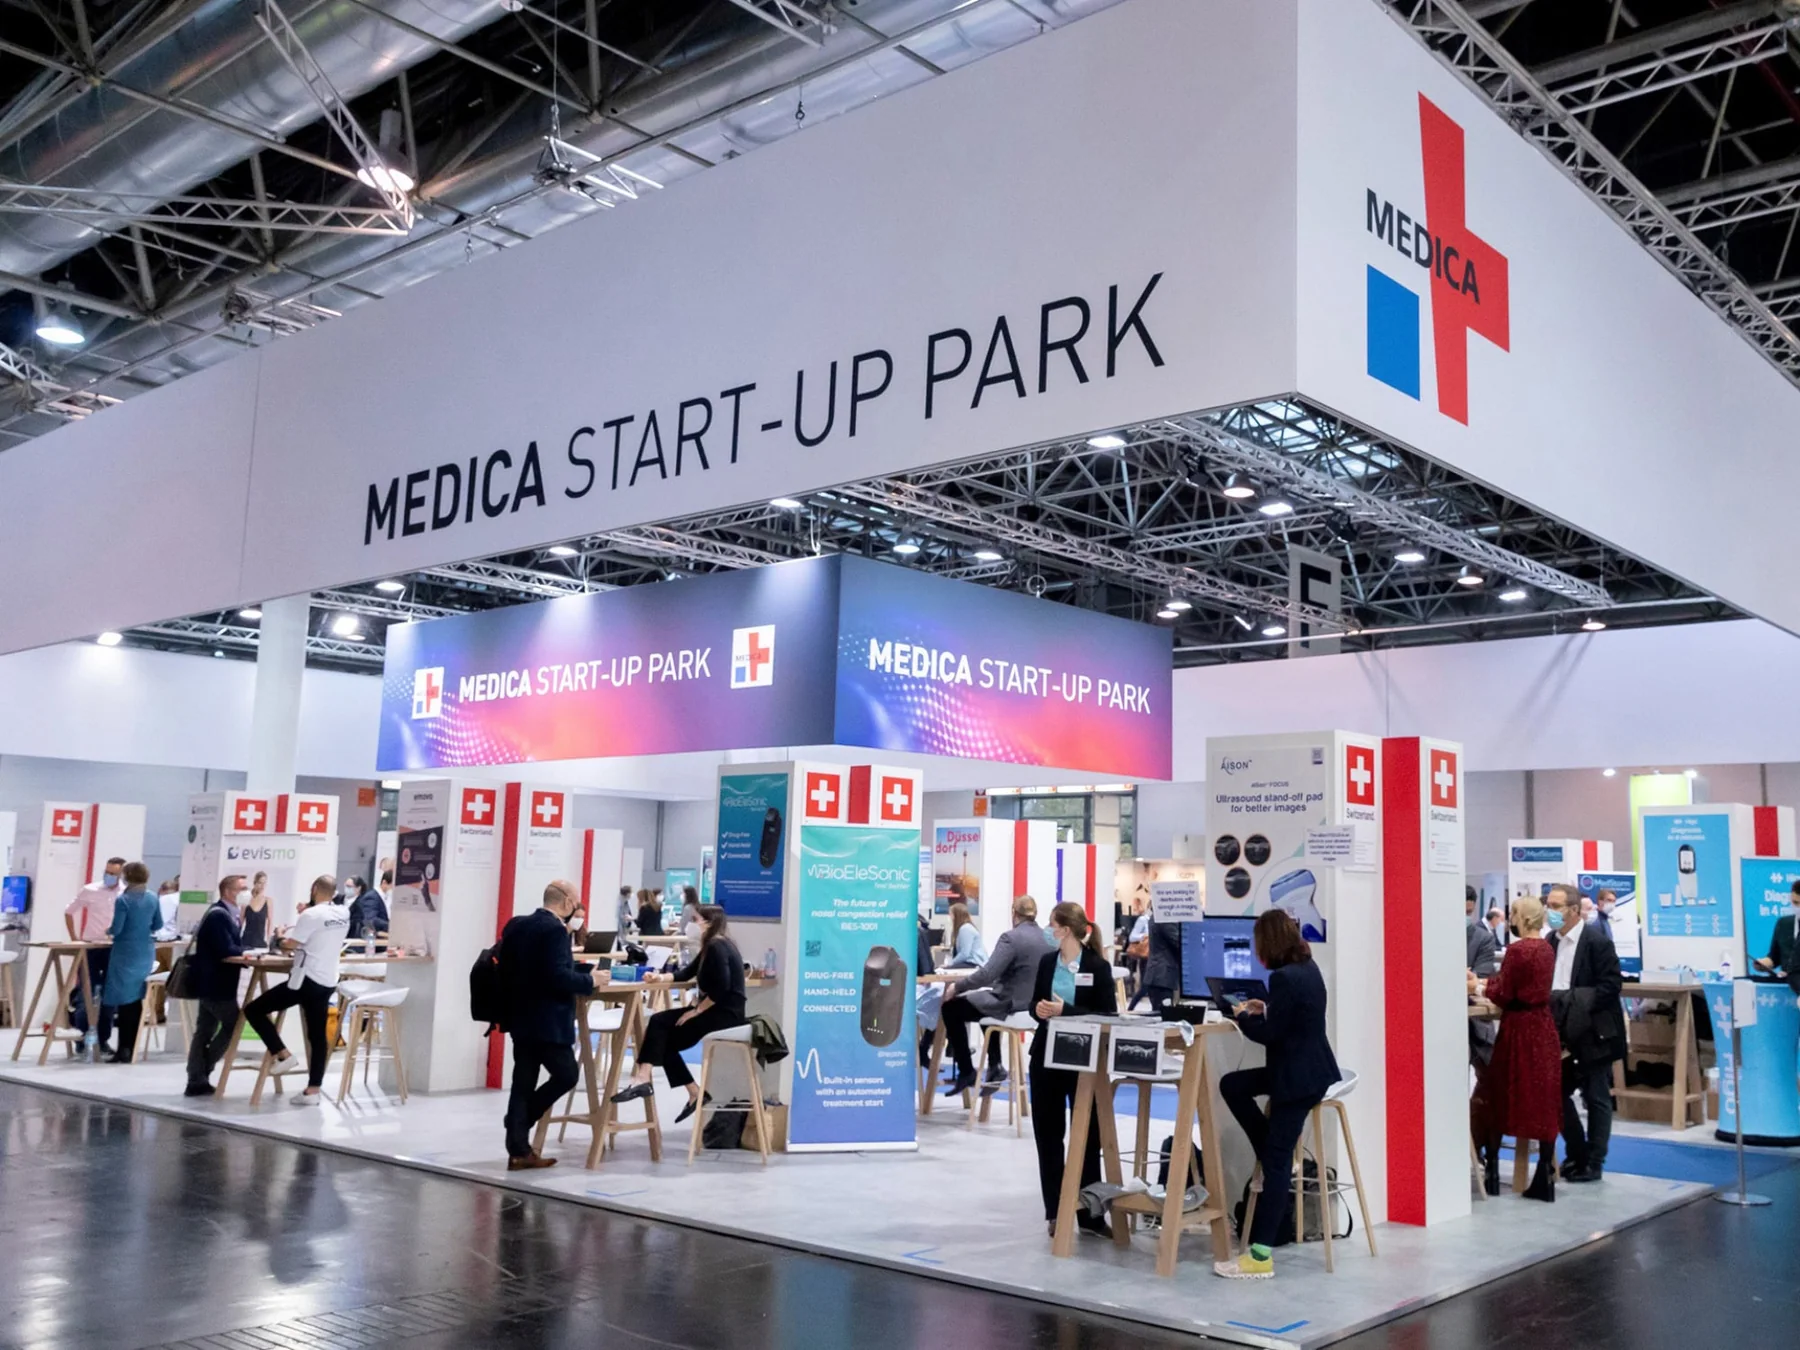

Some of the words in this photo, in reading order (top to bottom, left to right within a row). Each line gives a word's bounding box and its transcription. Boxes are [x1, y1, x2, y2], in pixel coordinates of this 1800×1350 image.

[1366, 187, 1480, 304] MEDICA
[364, 440, 545, 545] MEDICA
[565, 349, 893, 498] START-UP
[925, 271, 1165, 419] PARK
[459, 668, 531, 703] MEDICA
[537, 655, 643, 694] START-UP
[648, 647, 711, 683] PARK
[869, 638, 972, 687] MEDICA
[979, 658, 1092, 706] START-UP
[1097, 679, 1151, 715] PARK
[1216, 794, 1261, 803] Ultrasound
[1264, 792, 1303, 802] stand-off
[1306, 792, 1323, 802] pad
[1231, 804, 1243, 812] for
[1245, 804, 1271, 812] better
[1274, 803, 1306, 814] images
[242, 846, 296, 860] evismo
[936, 842, 957, 853] dorf
[812, 864, 911, 880] BioEleSonic
[833, 899, 849, 907] The
[851, 898, 877, 907] future
[878, 899, 888, 907] of
[811, 910, 836, 918] nasal
[837, 910, 884, 919] congestion
[886, 910, 908, 918] relief
[804, 971, 855, 980] DRUG-FREE
[803, 988, 856, 996] HAND-HELD
[803, 1004, 857, 1013] CONNECTED
[823, 1076, 852, 1085] Built-in
[854, 1077, 884, 1085] sensors
[816, 1087, 834, 1096] with
[847, 1087, 892, 1096] automated
[823, 1099, 864, 1108] treatment
[864, 1099, 884, 1107] start
